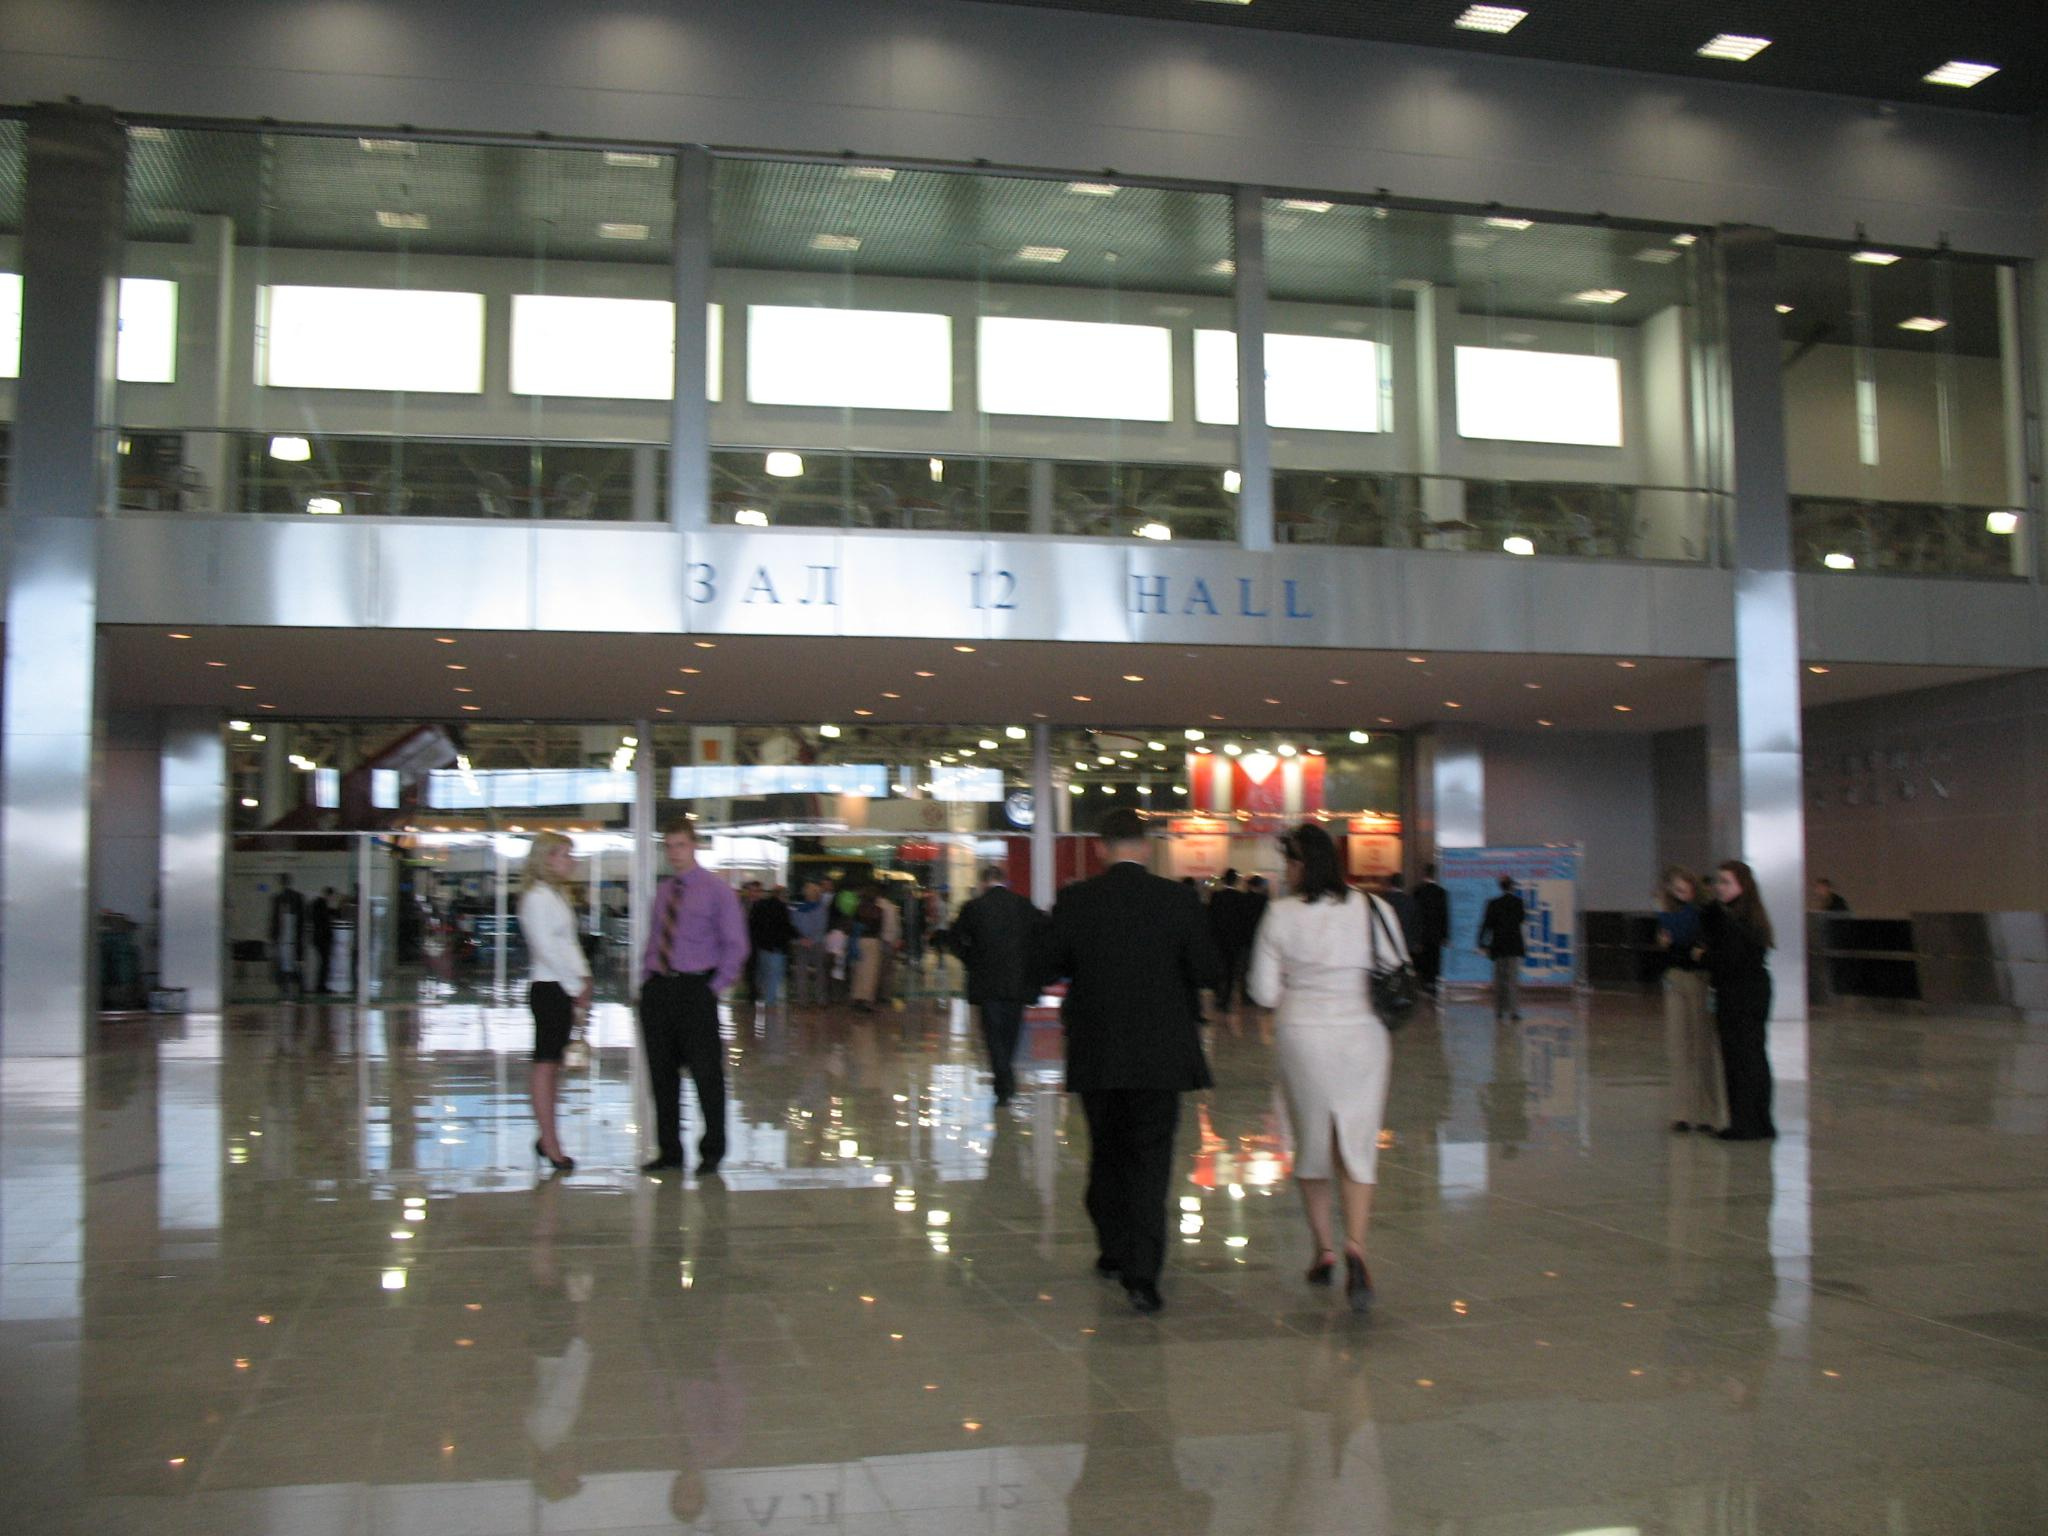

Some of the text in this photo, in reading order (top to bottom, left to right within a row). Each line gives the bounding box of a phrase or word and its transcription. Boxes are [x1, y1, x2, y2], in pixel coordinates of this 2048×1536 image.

[687, 562, 1313, 618] ЗАЛ 12 HALL
